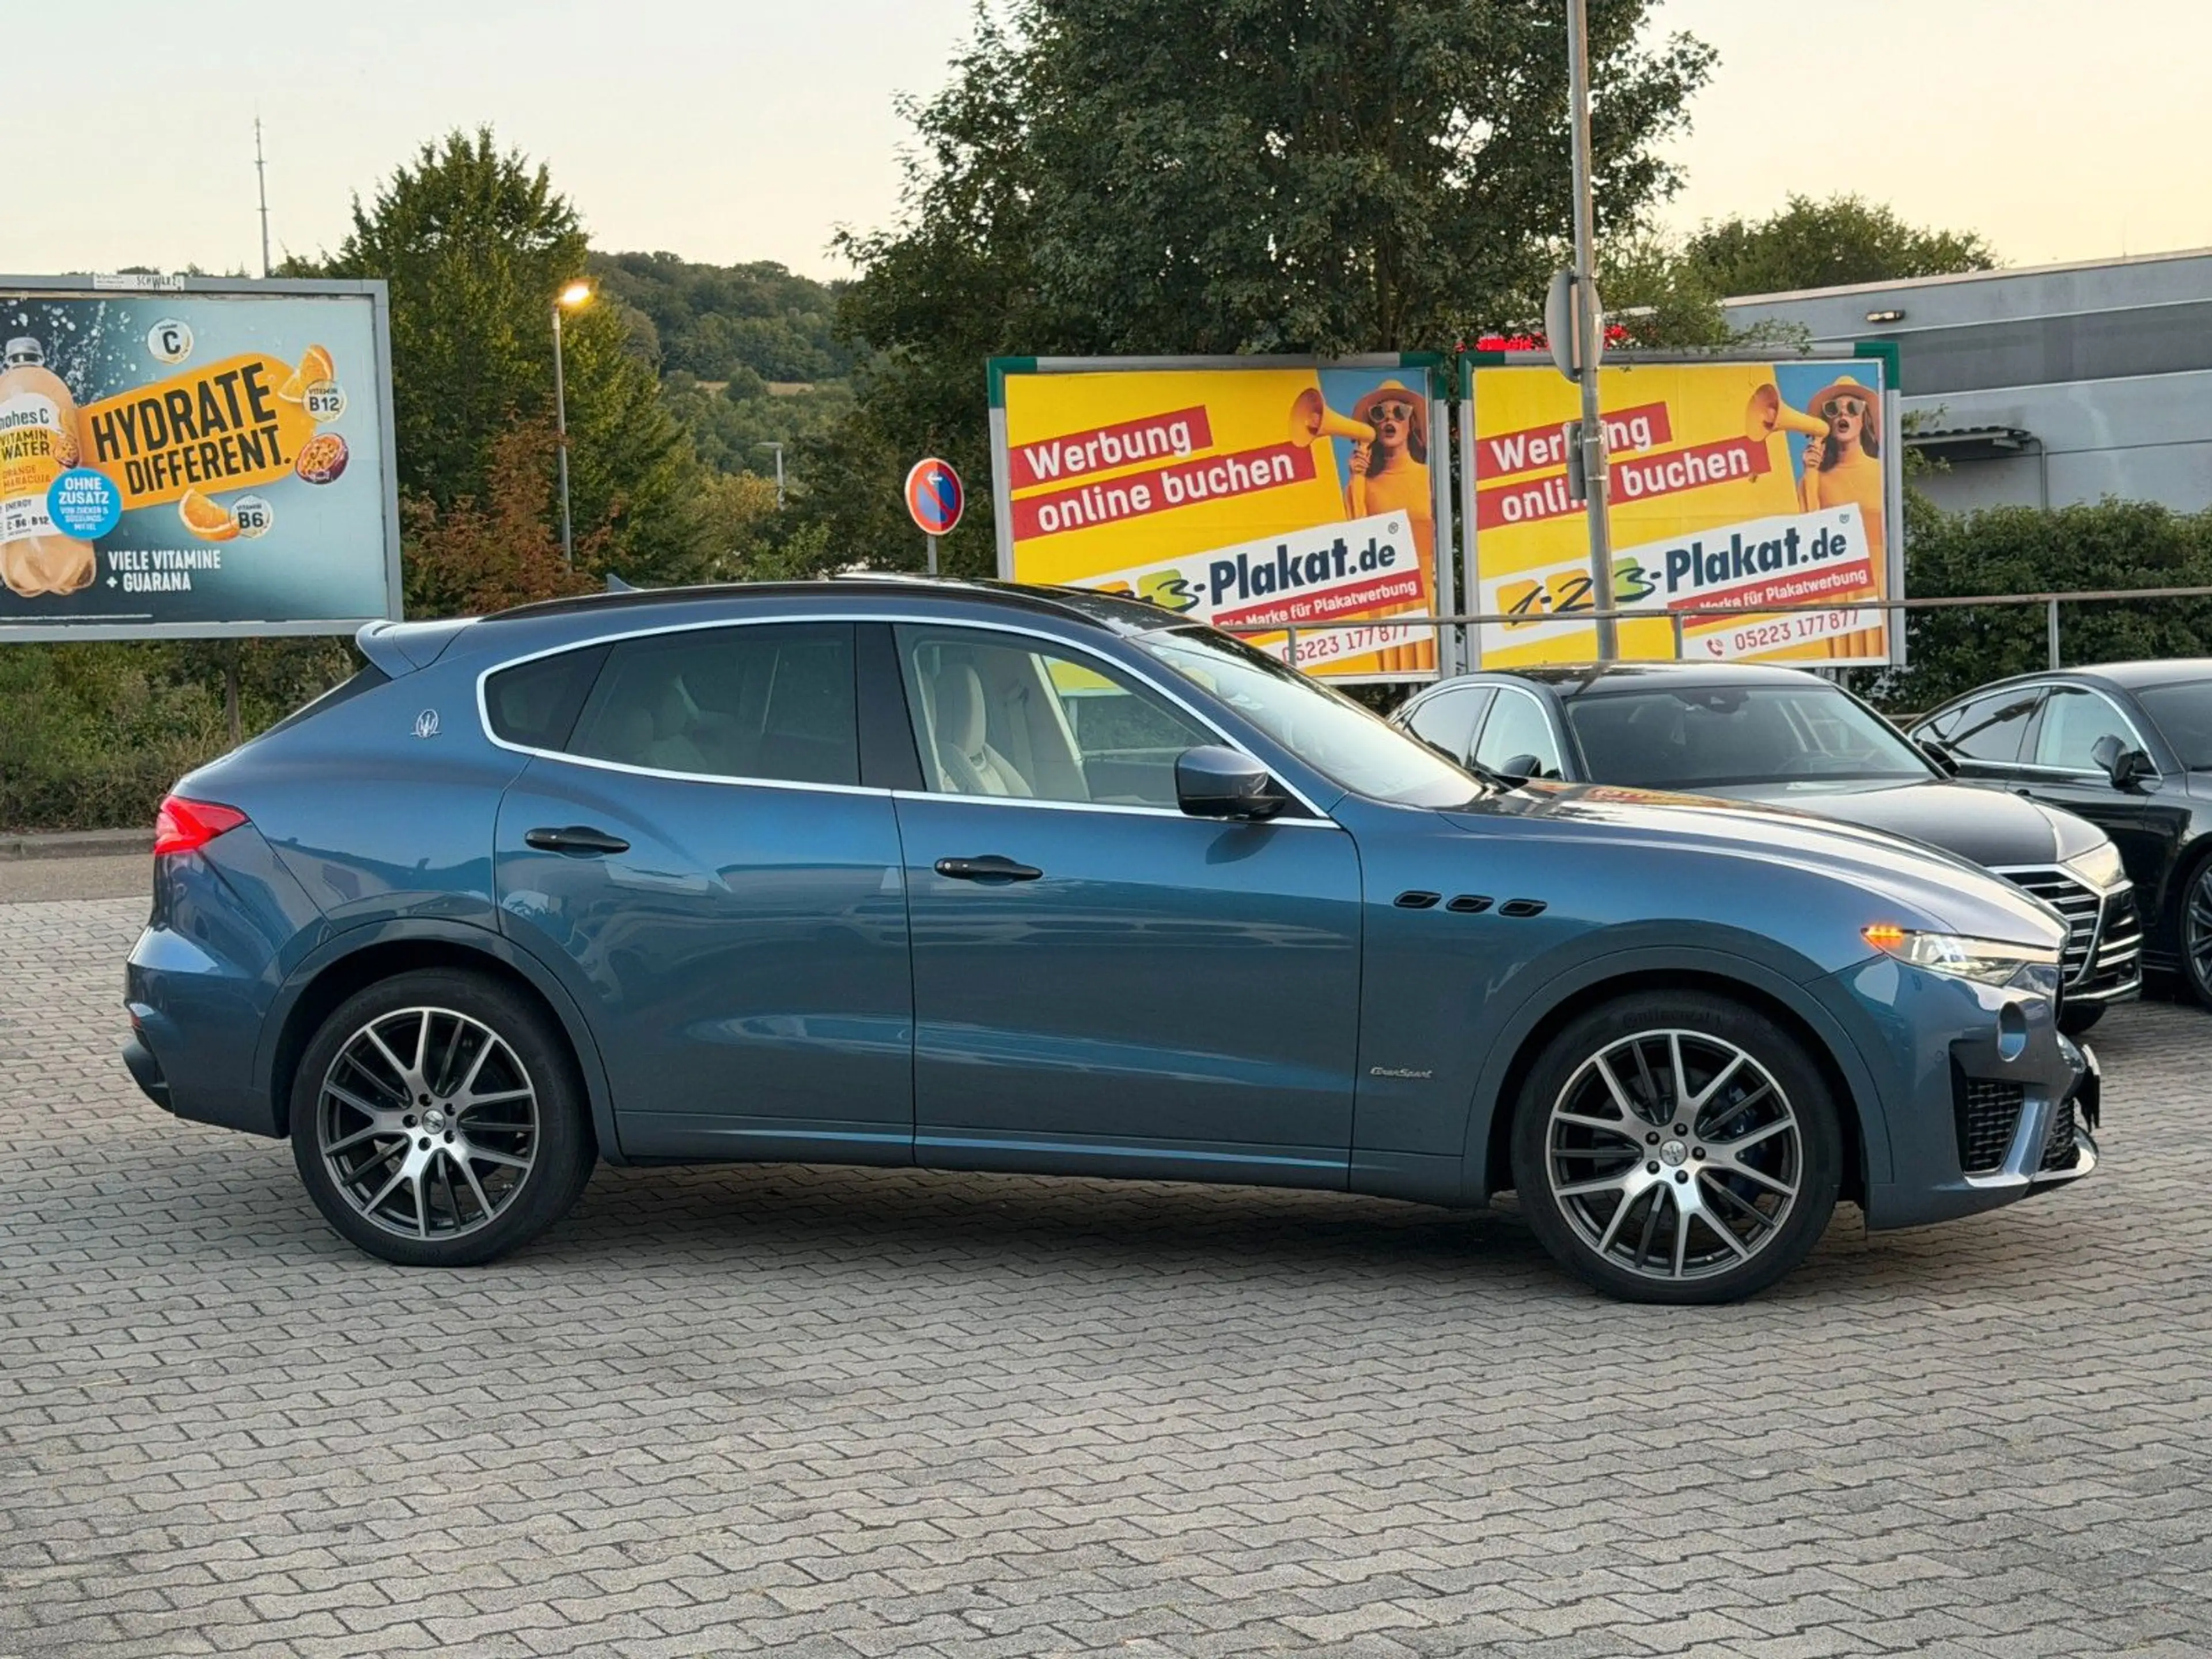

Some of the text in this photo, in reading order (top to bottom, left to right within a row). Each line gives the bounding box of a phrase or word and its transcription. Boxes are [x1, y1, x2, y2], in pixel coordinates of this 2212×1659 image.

[163, 330, 181, 355] C
[91, 362, 277, 463] HYDRATE
[309, 397, 340, 411] B12
[0, 429, 48, 446] VITAMIN
[1, 441, 51, 460] WATER
[1024, 421, 1192, 480] Werbung
[1490, 415, 1652, 472] Werng
[124, 424, 291, 496] DIFFERENT.
[65, 477, 103, 491] OHNE
[1037, 454, 1295, 532] online buchen
[1501, 446, 1750, 522] onli buchen
[58, 491, 109, 505] ZUSATZ
[238, 512, 264, 529] B6
[108, 549, 221, 571] VIELE VITAMINE
[123, 570, 192, 593] GUARANA
[1743, 590, 1763, 607] für
[1766, 569, 1868, 601] Plakatwerbung
[1290, 602, 1312, 619] für
[1314, 581, 1418, 614] Plakatwerbung
[1734, 623, 1791, 650] 05223
